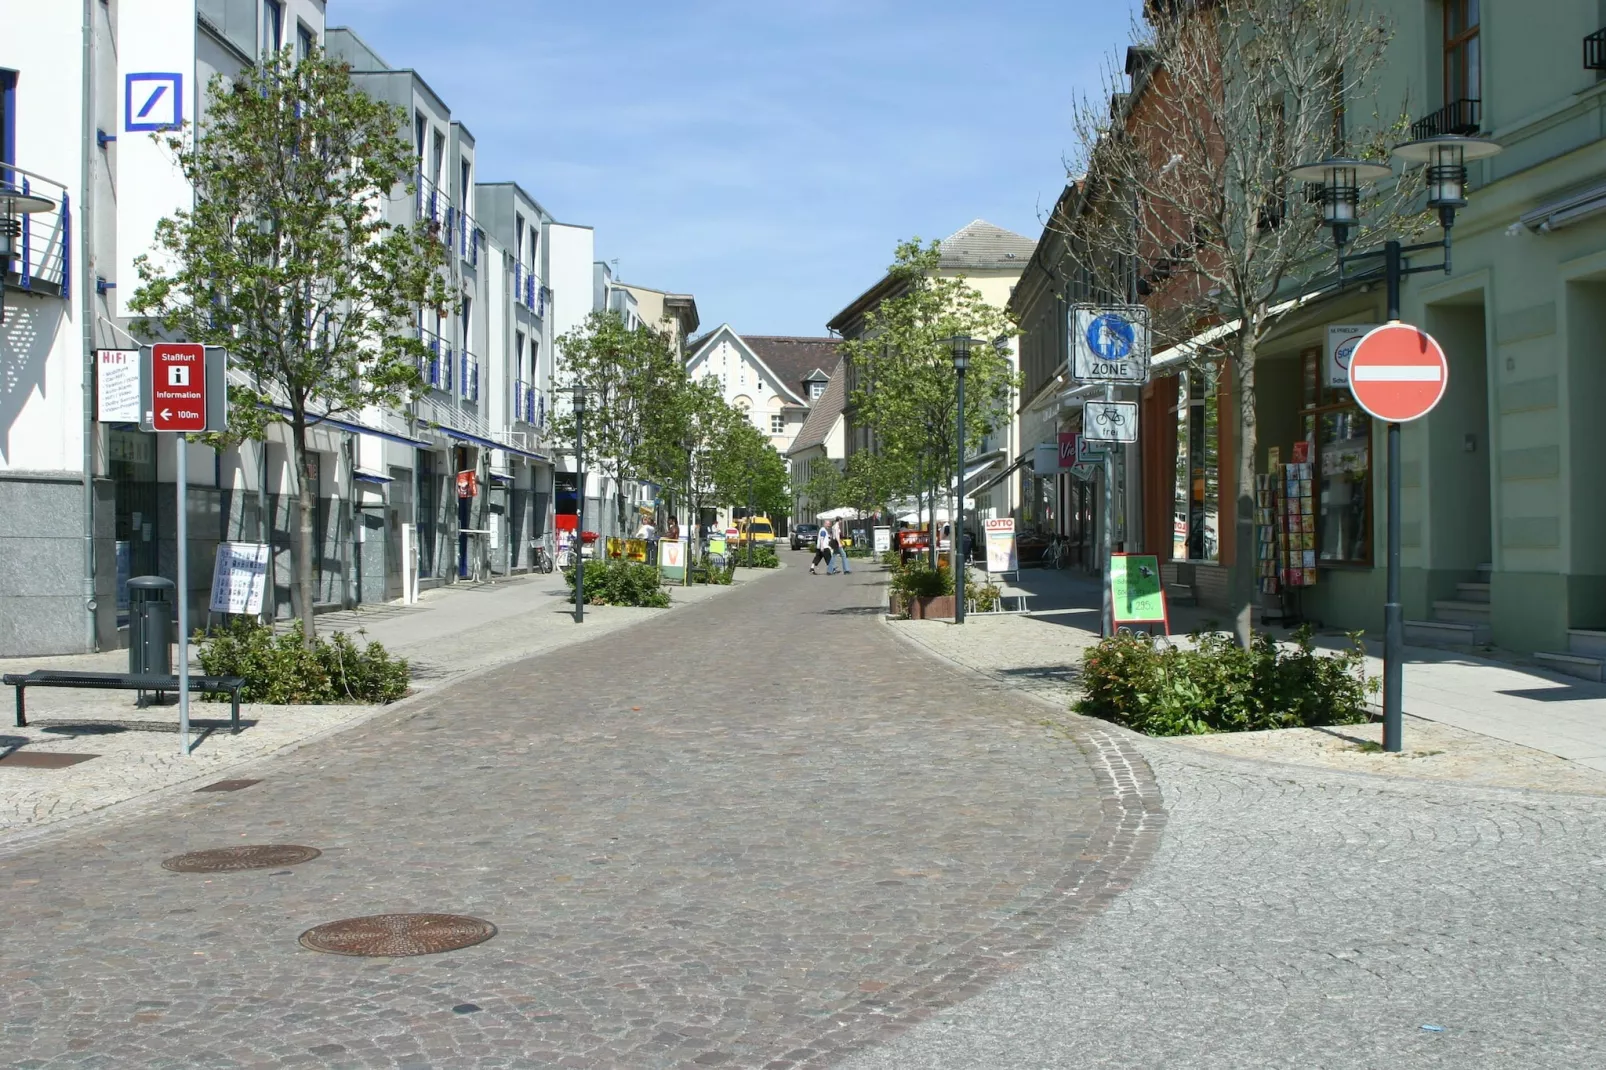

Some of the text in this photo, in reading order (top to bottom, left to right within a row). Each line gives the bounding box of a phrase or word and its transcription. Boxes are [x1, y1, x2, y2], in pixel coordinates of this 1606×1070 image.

[161, 353, 196, 361] Staßfurt
[1338, 347, 1353, 358] SCH
[1092, 363, 1128, 375] ZONE
[156, 390, 202, 399] Information
[177, 410, 199, 419] 100m
[1102, 427, 1119, 436] frei
[985, 519, 1013, 528] LOTTO
